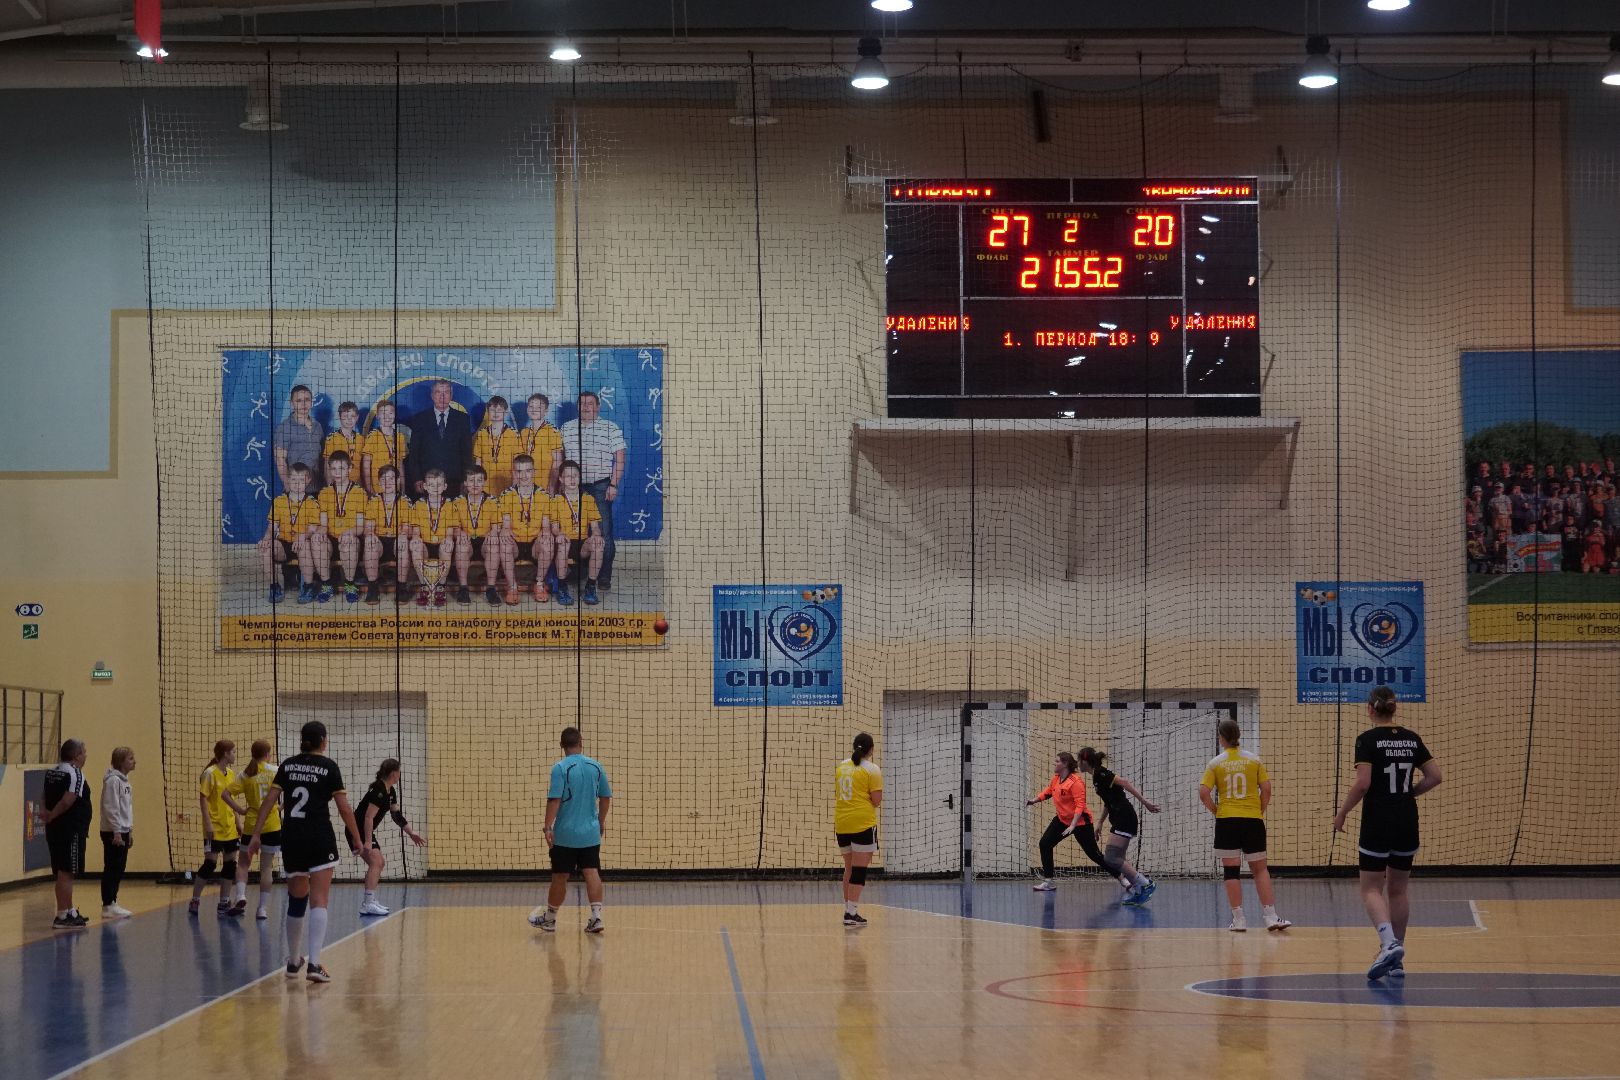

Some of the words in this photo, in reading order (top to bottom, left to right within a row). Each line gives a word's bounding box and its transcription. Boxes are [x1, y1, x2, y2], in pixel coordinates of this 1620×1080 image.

[989, 215, 1029, 247] 27
[1064, 220, 1078, 242] 2
[1134, 215, 1173, 246] 20
[886, 317, 970, 330] УДАЛЕНИЯ
[1170, 315, 1256, 330] УДАЛЕНИЯ
[1036, 332, 1096, 346] ПЕРИОД
[1516, 611, 1596, 622] Воспитанники
[1599, 612, 1620, 622] спо
[238, 620, 303, 630] Чемпионы
[306, 620, 377, 631] первенства
[380, 618, 424, 629] России
[427, 620, 442, 628] по
[446, 618, 501, 630] гандболу
[505, 619, 541, 630] среди
[545, 617, 595, 628] юношей
[598, 617, 625, 627] 2003
[628, 619, 647, 628] г.р.
[243, 633, 250, 641] с
[253, 632, 347, 643] председателем
[351, 631, 394, 641] Совета
[397, 631, 460, 642] депутатов
[463, 631, 482, 640] г.о.
[485, 629, 548, 641] Егорьевск
[551, 629, 574, 639] М.Т.
[578, 629, 642, 640] Лавровым
[720, 609, 760, 660] МЫ
[1302, 607, 1343, 657] МЫ
[1376, 740, 1418, 749] МОСКОВСКАЯ
[1385, 749, 1414, 757] ОБЛАСТЬ
[284, 763, 329, 776] МОСКОВСКАЯ
[289, 773, 319, 782] ОБЛАСТЬ
[1383, 762, 1413, 793] 17
[1224, 772, 1247, 799] 10
[290, 786, 310, 819] 2
